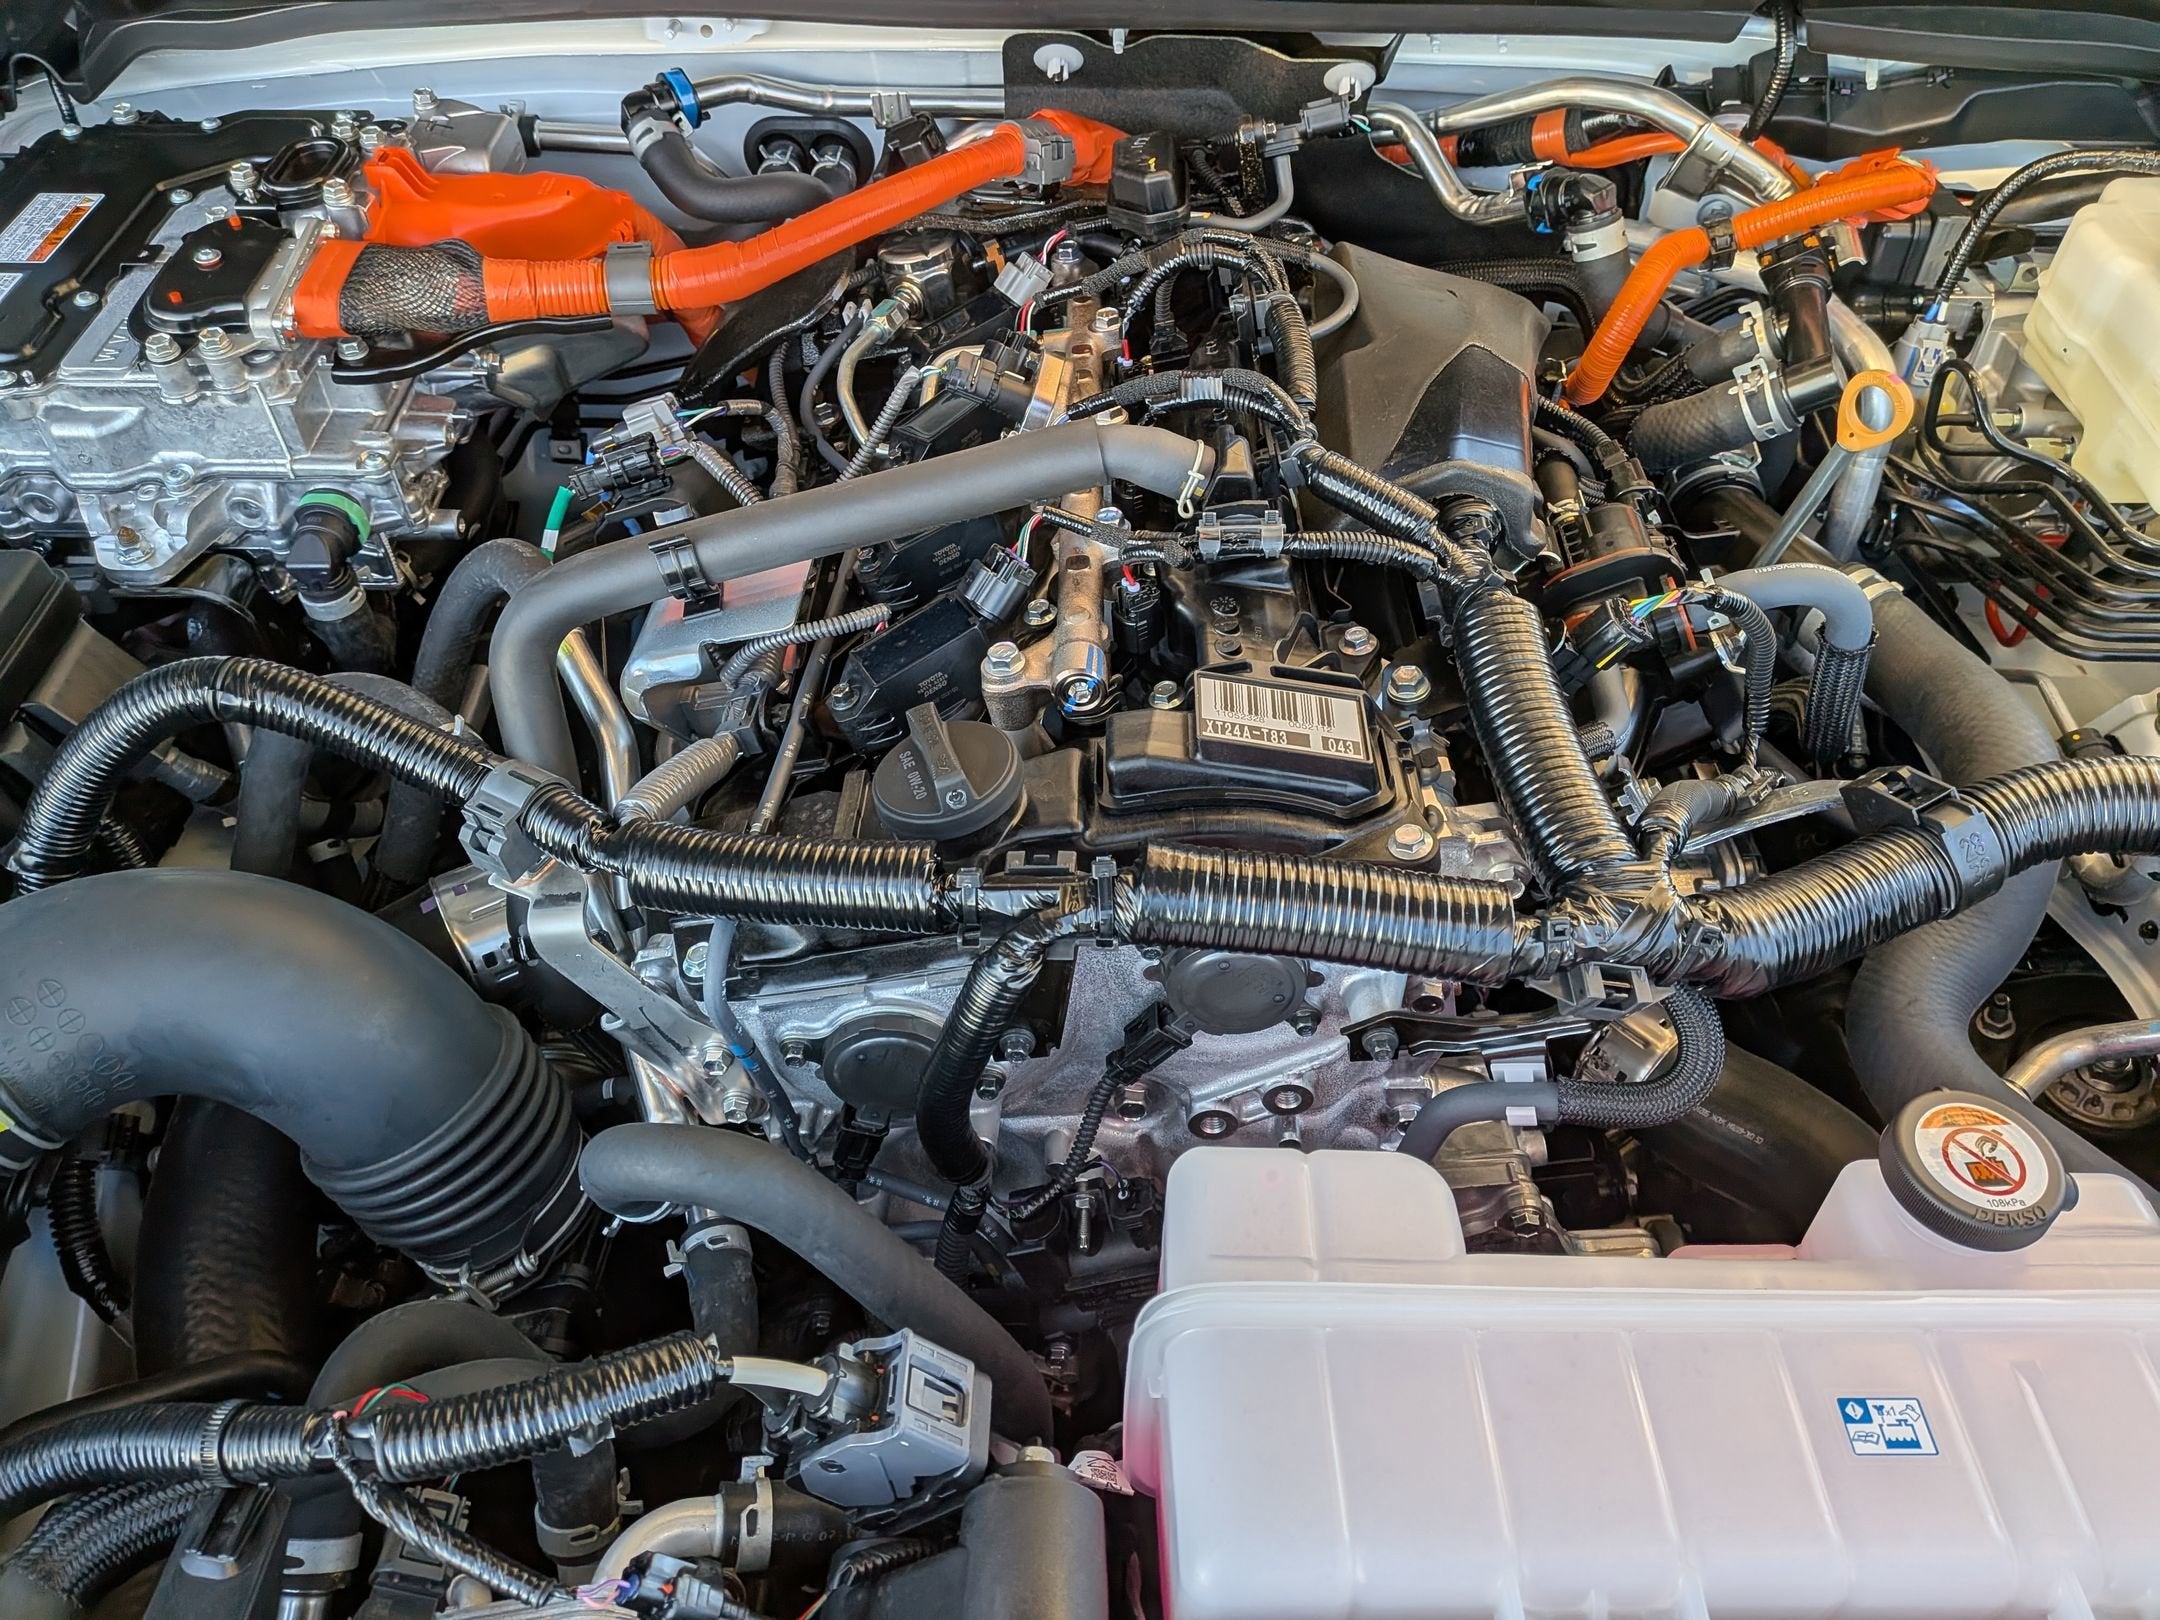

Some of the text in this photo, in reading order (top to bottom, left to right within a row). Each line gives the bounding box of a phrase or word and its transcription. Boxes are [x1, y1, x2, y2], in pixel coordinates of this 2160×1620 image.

[933, 543, 957, 557] TOYOTA
[938, 551, 961, 566] DENSO
[918, 671, 944, 687] TOYOTA
[924, 680, 948, 698] DENSO
[1205, 720, 1288, 745] XT24A-T83
[1328, 738, 1354, 755] 043
[899, 750, 916, 770] SAE
[1959, 832, 1986, 863] 28
[1986, 1198, 2026, 1209] 108kPa
[1974, 1205, 2048, 1227] DENSO
